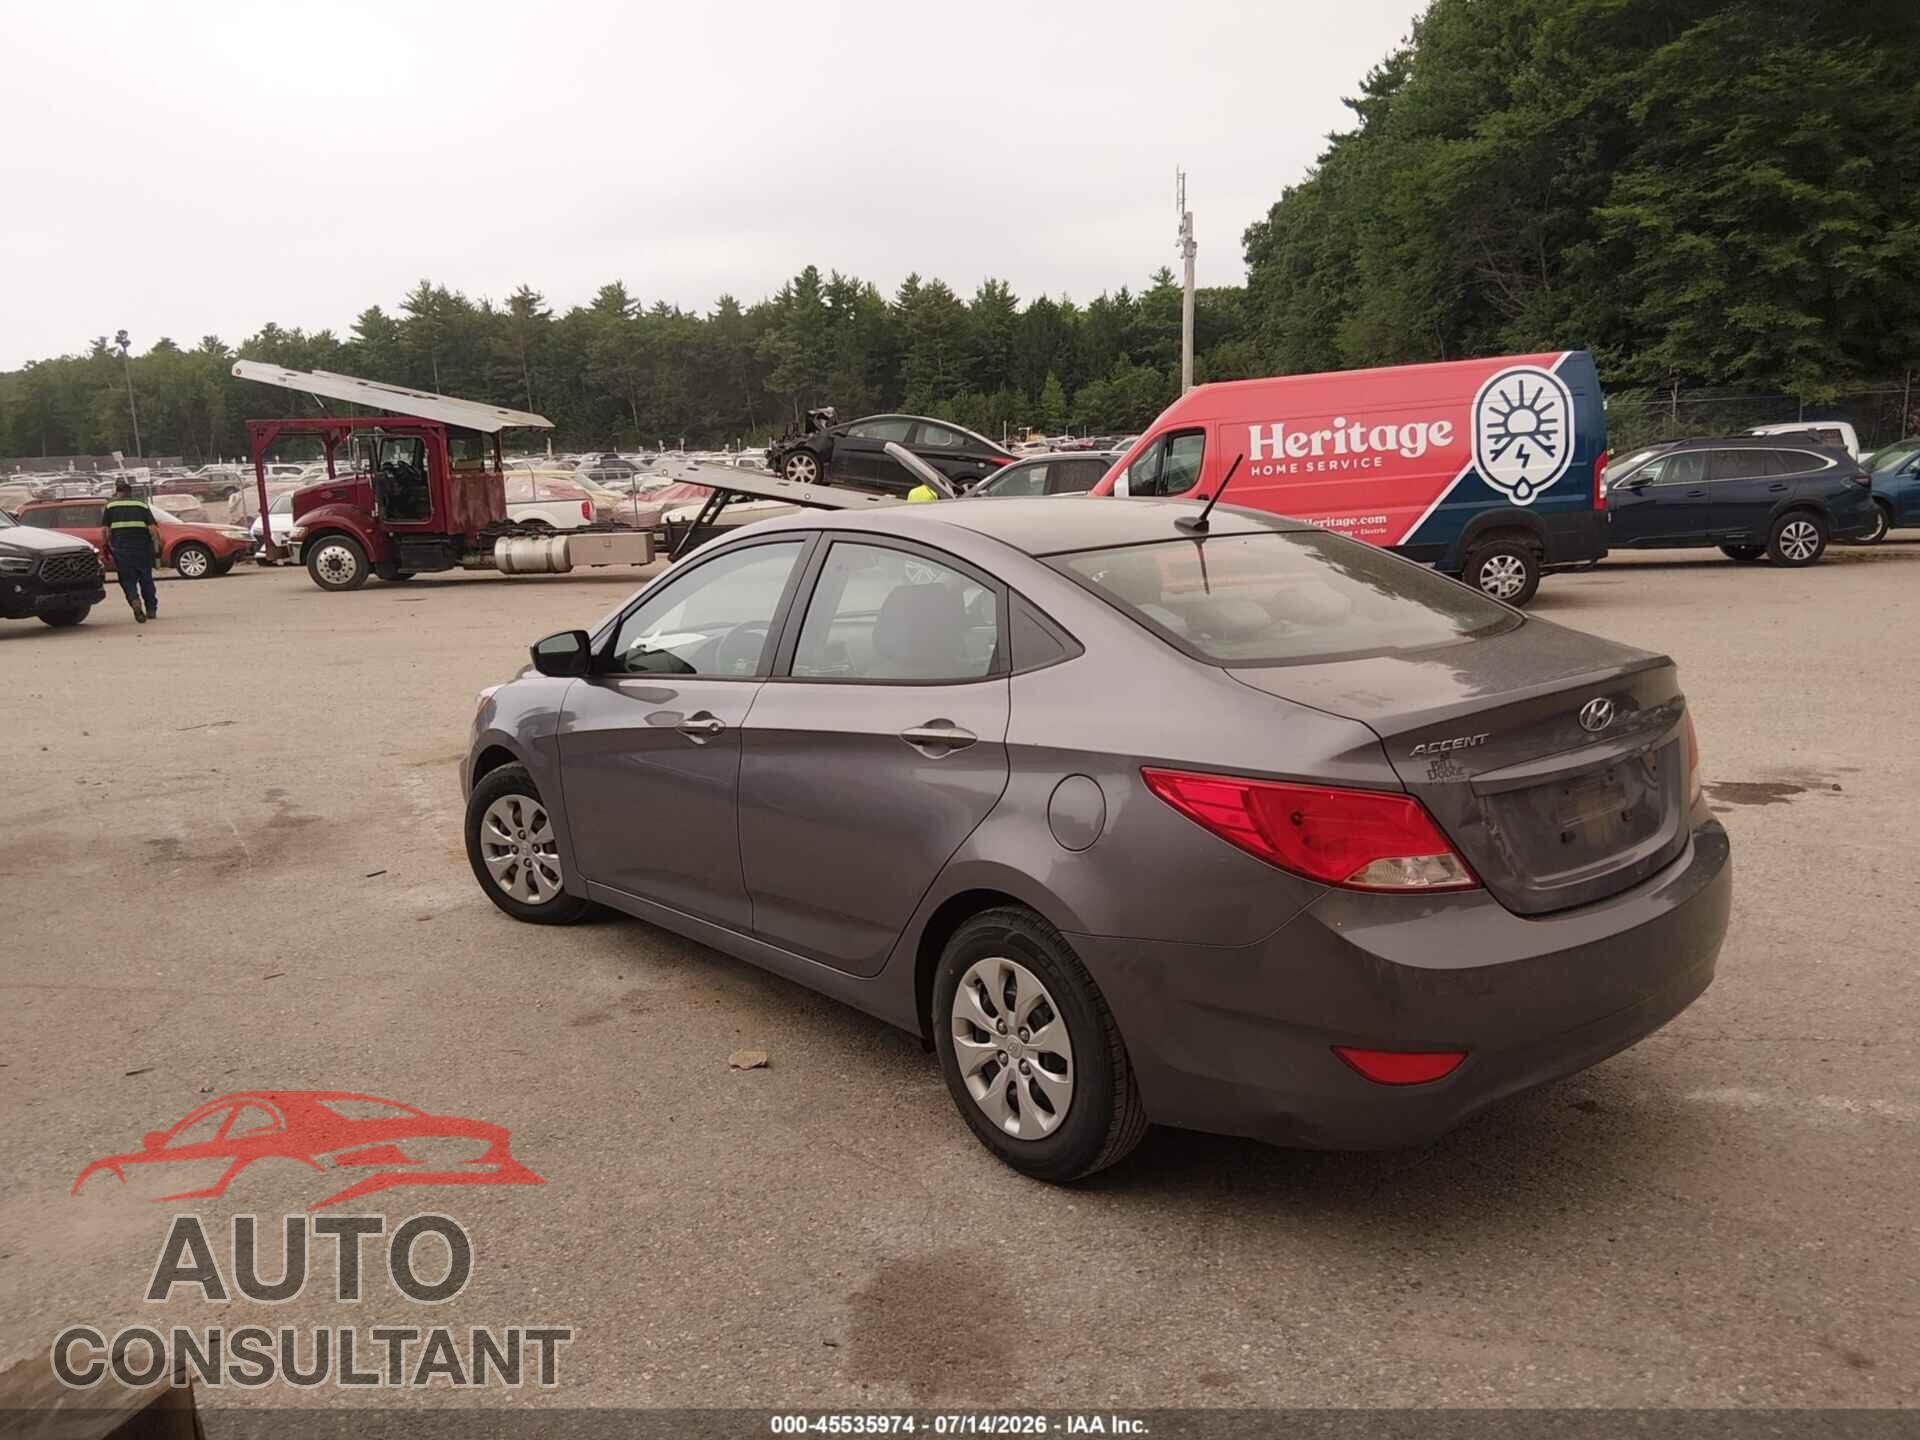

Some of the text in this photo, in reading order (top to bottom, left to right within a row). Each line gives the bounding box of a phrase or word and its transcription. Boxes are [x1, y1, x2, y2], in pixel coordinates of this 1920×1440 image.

[1248, 416, 1455, 460] Heritage
[1251, 456, 1384, 476] HOME SERVICE
[1408, 732, 1491, 757] ACCENT
